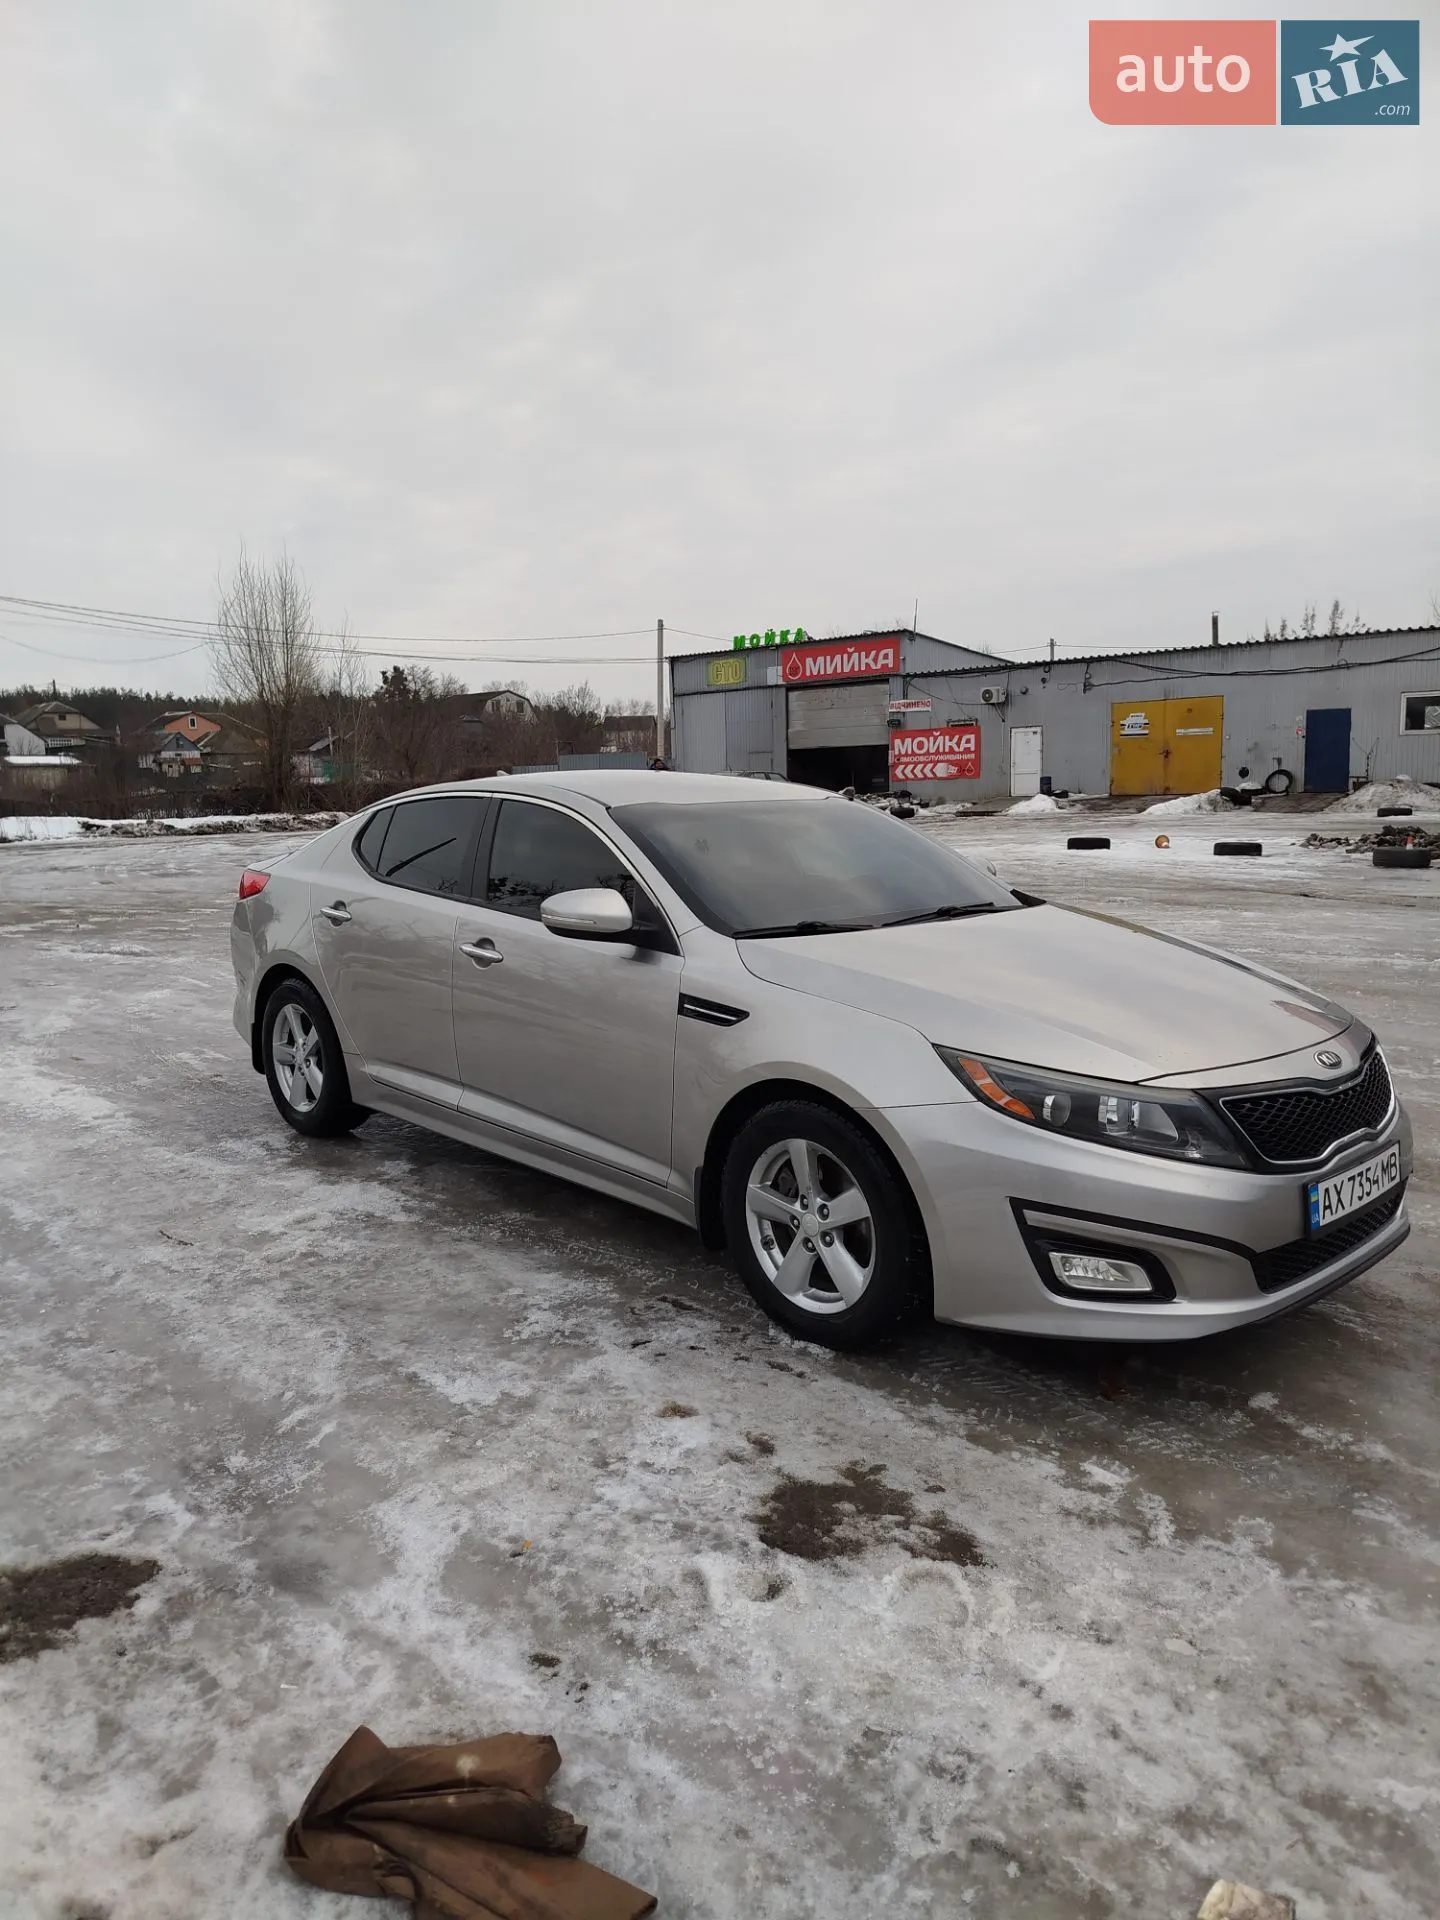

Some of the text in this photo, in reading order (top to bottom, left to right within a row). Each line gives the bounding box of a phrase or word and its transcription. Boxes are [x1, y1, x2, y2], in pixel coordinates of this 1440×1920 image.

[733, 627, 806, 650] МОЙКА
[711, 660, 742, 684] СТО
[805, 647, 894, 677] МИЙКА
[894, 730, 976, 755] МОЙКА
